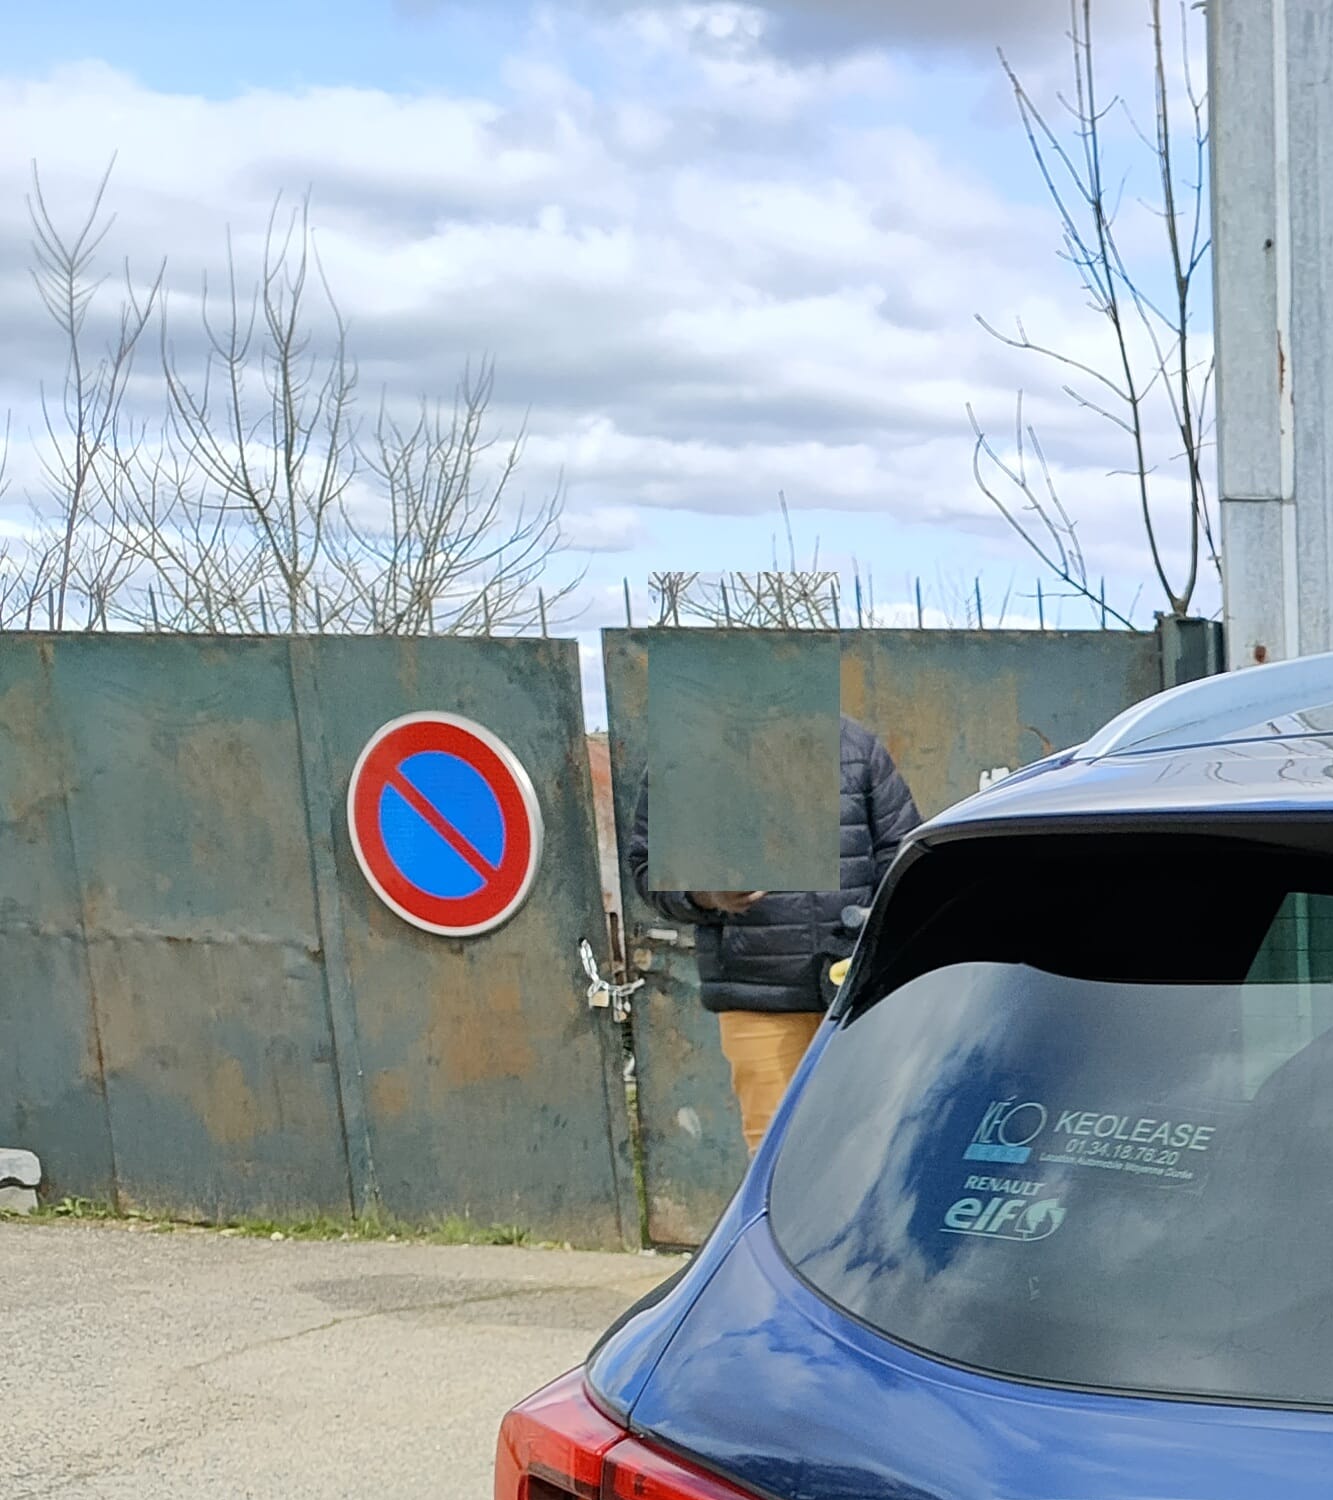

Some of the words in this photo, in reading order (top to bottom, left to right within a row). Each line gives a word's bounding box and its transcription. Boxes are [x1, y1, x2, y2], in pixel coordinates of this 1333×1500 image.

[1053, 1110, 1217, 1151] KEOLEASE
[964, 1175, 1046, 1196] RENAULT
[944, 1197, 1027, 1232] elf
